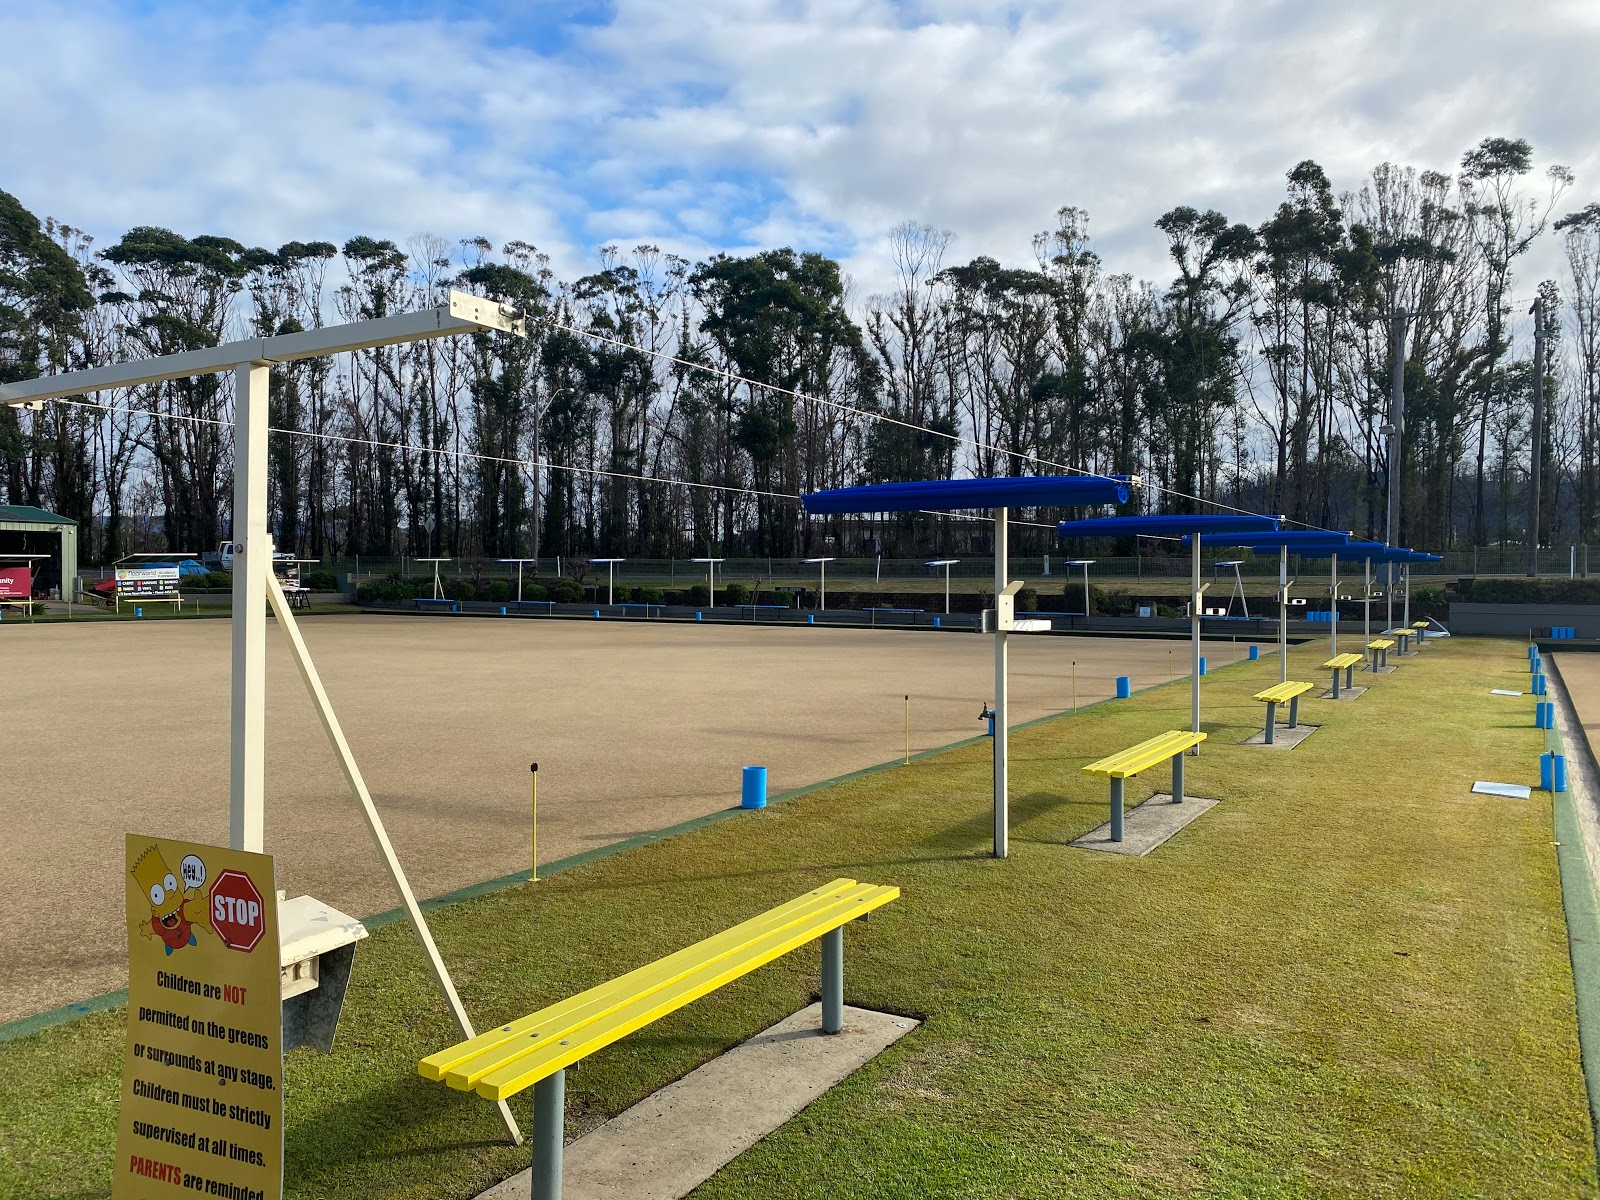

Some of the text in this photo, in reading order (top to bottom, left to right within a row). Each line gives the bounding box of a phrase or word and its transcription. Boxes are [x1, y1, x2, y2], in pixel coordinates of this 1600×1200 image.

[214, 895, 259, 927] STOP
[157, 970, 247, 1006] Children are NOT
[138, 1006, 269, 1049] permitted on the greens
[134, 1043, 276, 1090] or surrounds at any stage.
[133, 1078, 271, 1130] Children must be strictly
[133, 1120, 266, 1168] supervised at all times.
[129, 1155, 264, 1200] PARENTS are reminded
